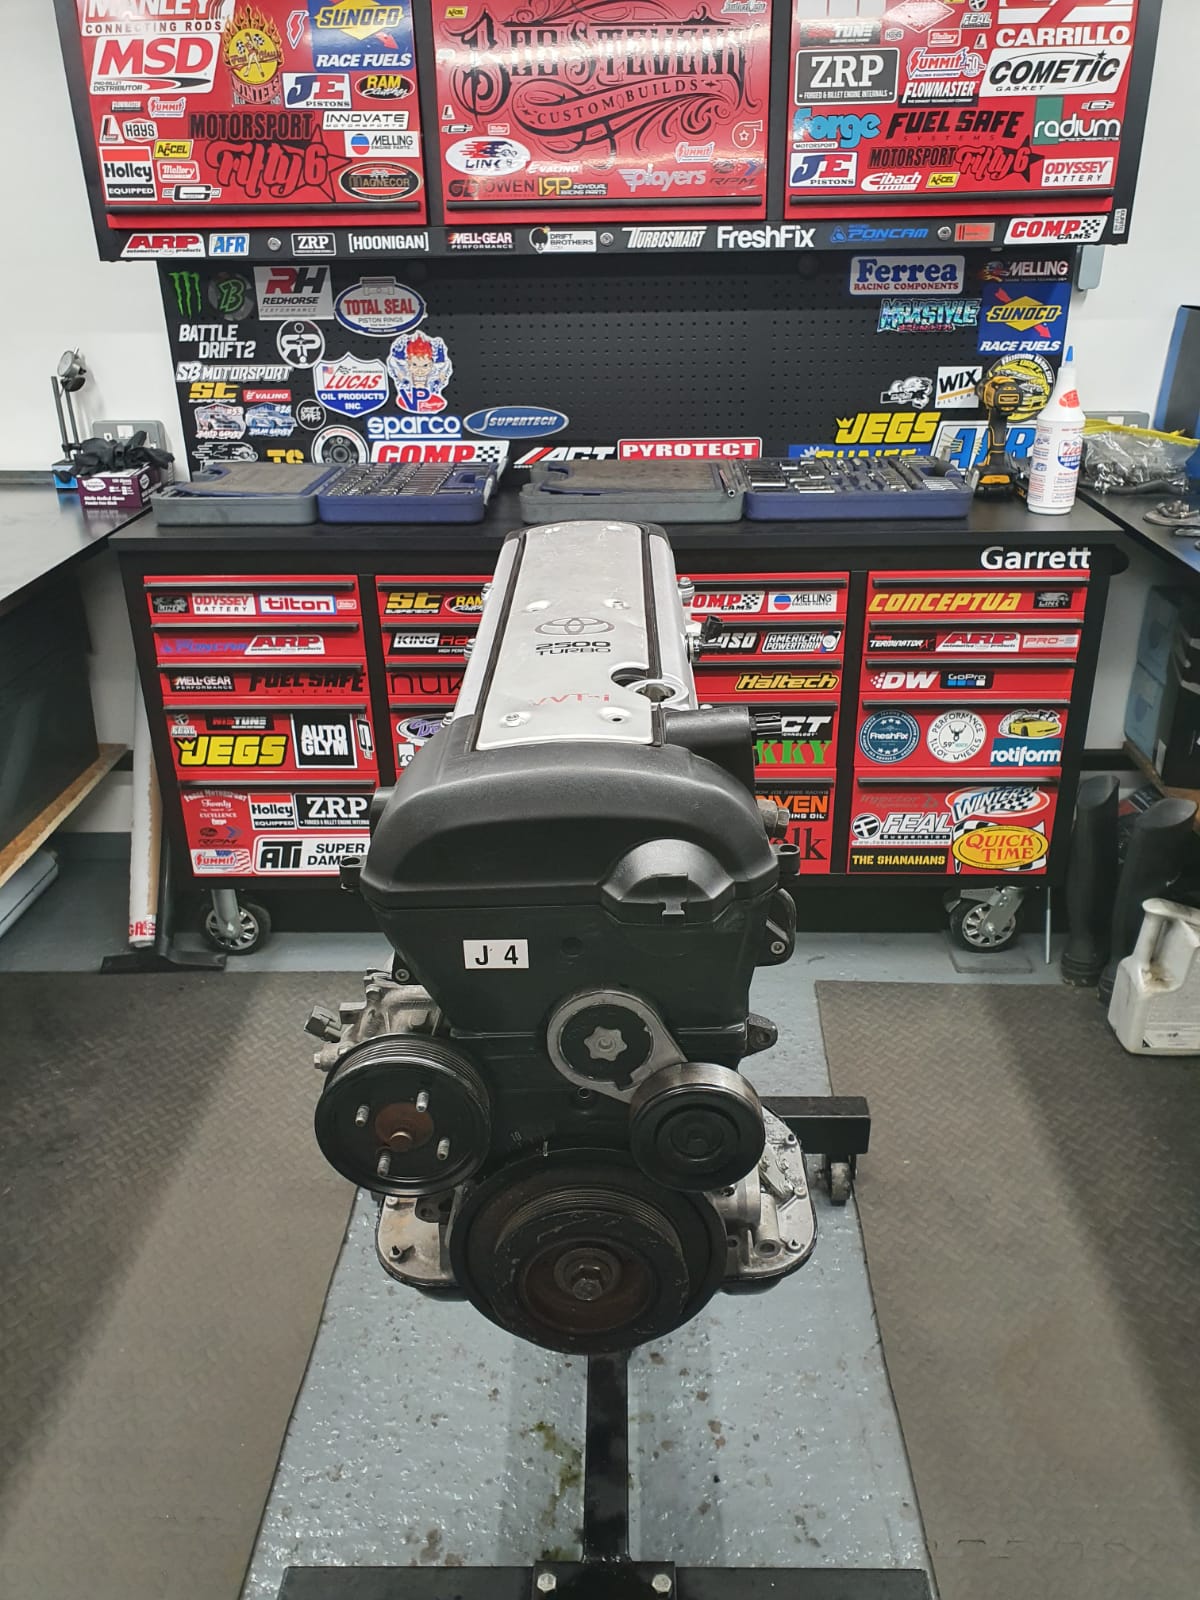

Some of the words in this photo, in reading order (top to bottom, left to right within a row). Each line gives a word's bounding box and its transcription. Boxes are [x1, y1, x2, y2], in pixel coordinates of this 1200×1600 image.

[319, 7, 401, 27] SUNOCO
[963, 14, 991, 25] FEAL
[186, 21, 222, 31] RODS
[996, 25, 1130, 47] CARRILLO
[98, 37, 213, 75] MSD
[316, 54, 361, 68] RACE
[362, 53, 412, 67] FUELS
[910, 50, 962, 73] SUMMIT
[810, 55, 884, 88] ZRP
[989, 56, 1120, 85] COMETIC
[93, 84, 143, 92] DISTRIBUTOR
[287, 75, 345, 105] JE
[366, 75, 402, 89] RAM
[625, 79, 699, 103] BUILDS
[902, 82, 976, 104] FLOWMASTER
[326, 113, 406, 122] INNOVATE
[537, 96, 616, 125] CUSTOM
[190, 113, 314, 140] MOTORSPORT
[886, 111, 950, 139] FUEL
[954, 110, 1025, 138] SAFE
[1033, 113, 1121, 138] radium
[371, 135, 413, 146] MELLING
[157, 143, 187, 156] ACCEL
[869, 147, 955, 168] MOTORSPORT
[104, 163, 152, 182] Holley
[792, 154, 853, 183] JE
[1045, 161, 1108, 174] ODYSSEY
[350, 175, 410, 188] MAGNECOR
[630, 164, 706, 192] players
[1044, 174, 1102, 183] BATTERY
[622, 226, 708, 249] TURBOSMART
[717, 225, 816, 249] FreshFix
[1010, 220, 1081, 239] COMP
[1056, 232, 1092, 240] CAMS
[129, 235, 202, 249] ARP
[213, 236, 246, 252] AFR
[298, 236, 328, 249] ZRP
[450, 232, 513, 244] MELL-GEAR
[856, 259, 958, 282] Ferrea
[1009, 260, 1069, 276] MELLING
[265, 268, 328, 294] RH
[854, 283, 890, 291] RACING
[894, 282, 959, 291] COMPONENTS
[262, 297, 320, 305] REDHORSE
[344, 300, 382, 315] TOTAL
[384, 299, 415, 314] SEAL
[989, 306, 1058, 320] SUNOCO
[179, 324, 239, 341] BATTLE
[199, 341, 256, 358] DRIFT2
[980, 341, 1020, 351] RACE
[1018, 340, 1061, 351] FUELS
[202, 366, 293, 381] MOTORSPORT
[939, 369, 978, 394] WIX
[325, 375, 382, 389] LUCAS
[338, 393, 385, 401] PRODUCTS
[400, 388, 430, 411] VP
[367, 416, 461, 440] sparco
[488, 415, 558, 427] SUPERTECH
[834, 412, 942, 444] JEGS
[622, 442, 757, 457] PYROTECT
[981, 546, 1092, 570] Garrett
[194, 596, 250, 606] ODYSSEY
[265, 598, 331, 610] tilton
[792, 594, 832, 602] MELLING
[251, 636, 321, 647] ARP
[397, 635, 436, 644] KING
[536, 641, 611, 650] 2500
[768, 632, 823, 643] AMERICAN
[869, 639, 921, 648] TERMINATOR
[948, 633, 1016, 644] ARP
[536, 648, 611, 656] TURBO
[766, 642, 821, 650] POWERTRAIN
[174, 676, 231, 685] MELL-GEAR
[737, 673, 838, 689] Haltech
[881, 671, 940, 689] DW
[948, 673, 986, 681] GoPro
[932, 712, 984, 734] PERFORMANCE
[301, 724, 346, 741] AUTO
[870, 732, 909, 740] FreshFix
[180, 735, 288, 766] JEGS
[301, 739, 349, 756] GLYM
[953, 738, 982, 760] WHEELS
[990, 749, 1061, 766] rotiform
[252, 805, 293, 817] Holley
[306, 797, 367, 818] ZRP
[953, 786, 1035, 822] WINTERS
[881, 813, 952, 833] FEAL
[315, 843, 365, 854] SUPER
[965, 833, 1034, 849] QUICK
[852, 855, 874, 865] THE
[877, 855, 946, 865] SHANAHANS
[981, 848, 1034, 863] TIME
[475, 945, 488, 966] J
[504, 944, 519, 965] 4
